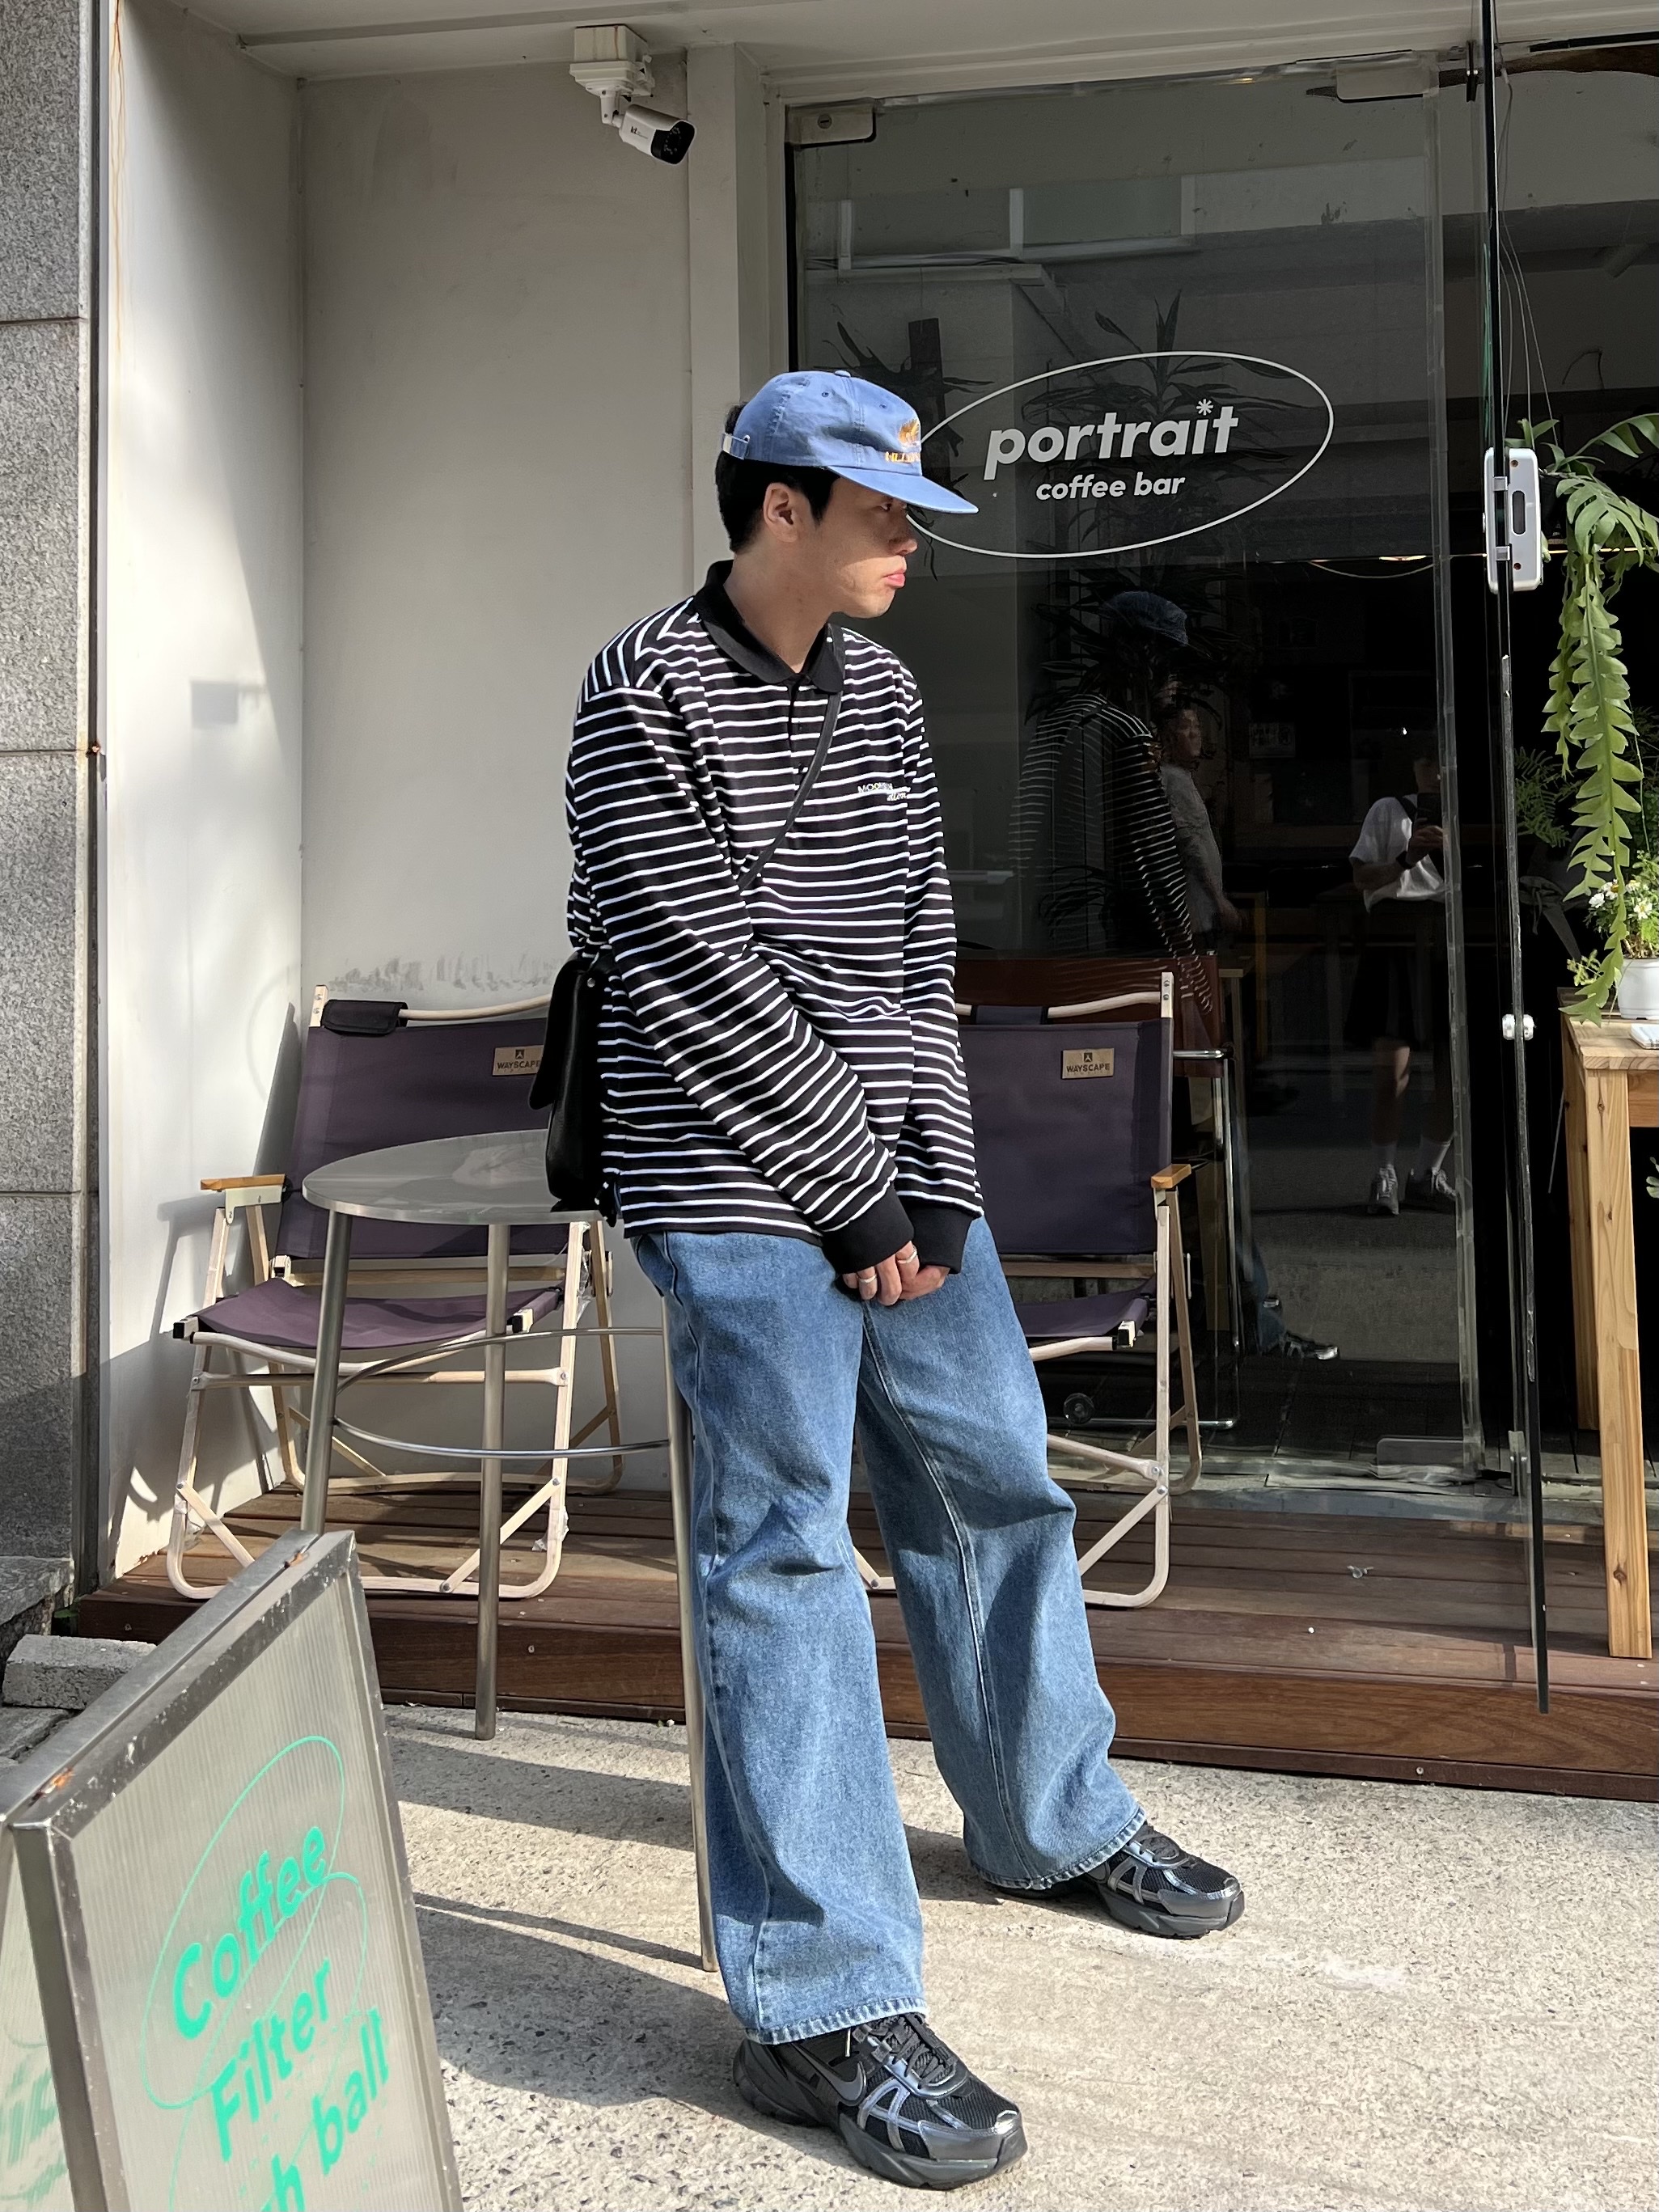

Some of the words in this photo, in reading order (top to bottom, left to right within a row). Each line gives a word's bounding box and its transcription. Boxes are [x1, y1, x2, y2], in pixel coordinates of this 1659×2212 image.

[983, 399, 1239, 480] portrait
[1035, 473, 1126, 501] coffee
[1133, 472, 1186, 497] bar
[1066, 1063, 1111, 1072] WAYSCAPE
[172, 1827, 326, 2040] Coffee
[209, 1957, 331, 2161] Filter
[311, 2007, 389, 2175] ball
